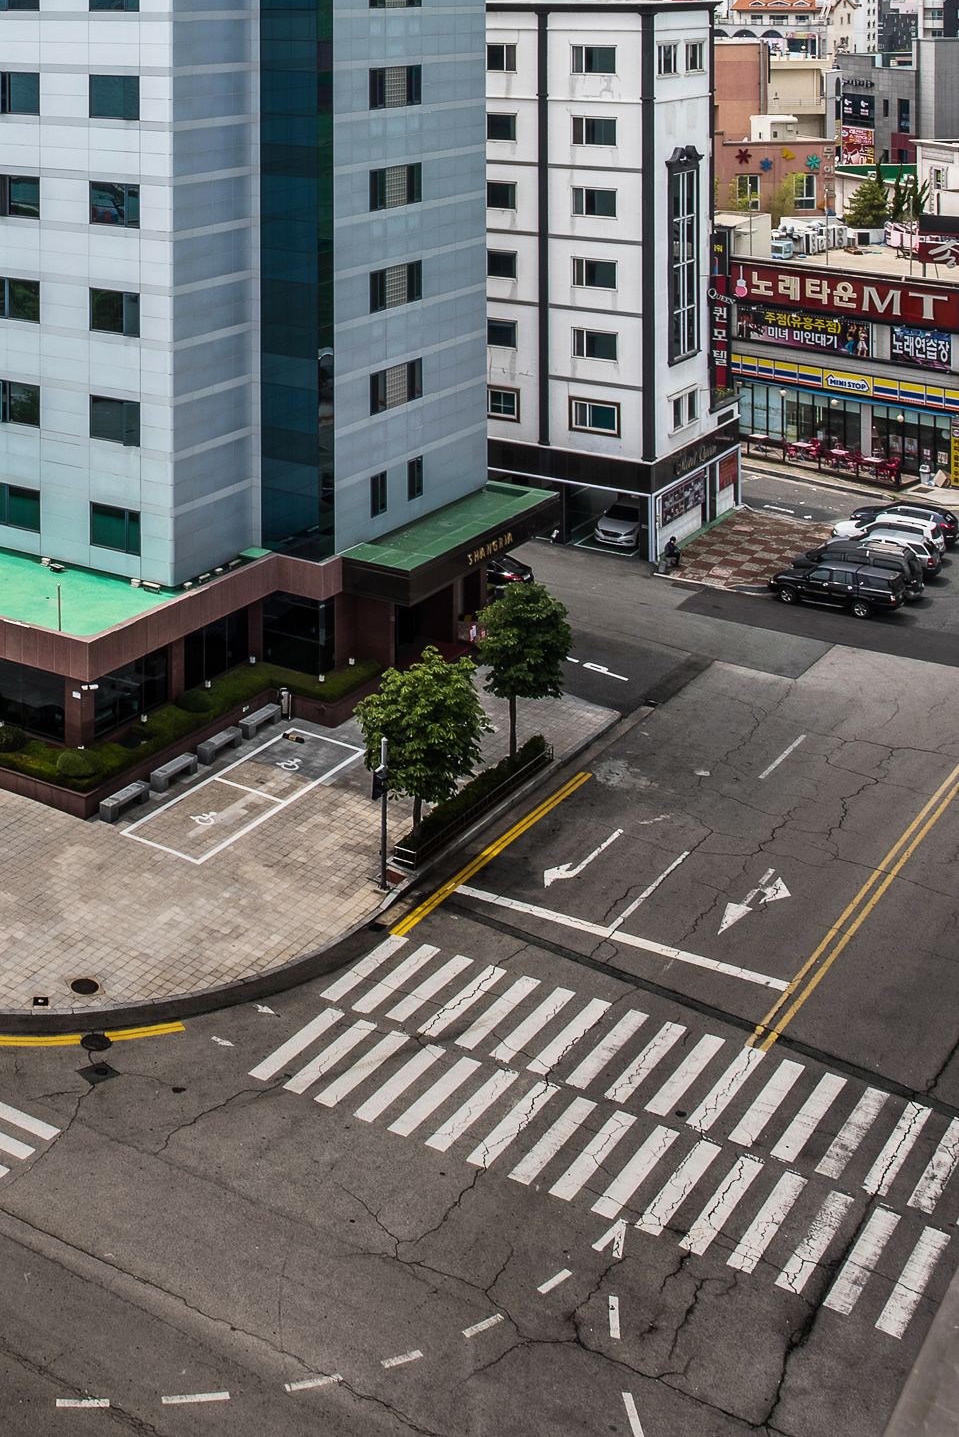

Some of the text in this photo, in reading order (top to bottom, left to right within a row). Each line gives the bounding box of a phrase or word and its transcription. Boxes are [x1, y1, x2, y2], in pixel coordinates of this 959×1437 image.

[707, 288, 736, 305] QUEEN
[764, 310, 842, 334] 주점(유흥주점)
[767, 326, 838, 349] 미녀 미인대기
[892, 334, 949, 362] 노래연습장
[829, 378, 867, 391] MINI STOP
[467, 532, 513, 565] SHANGRIA
